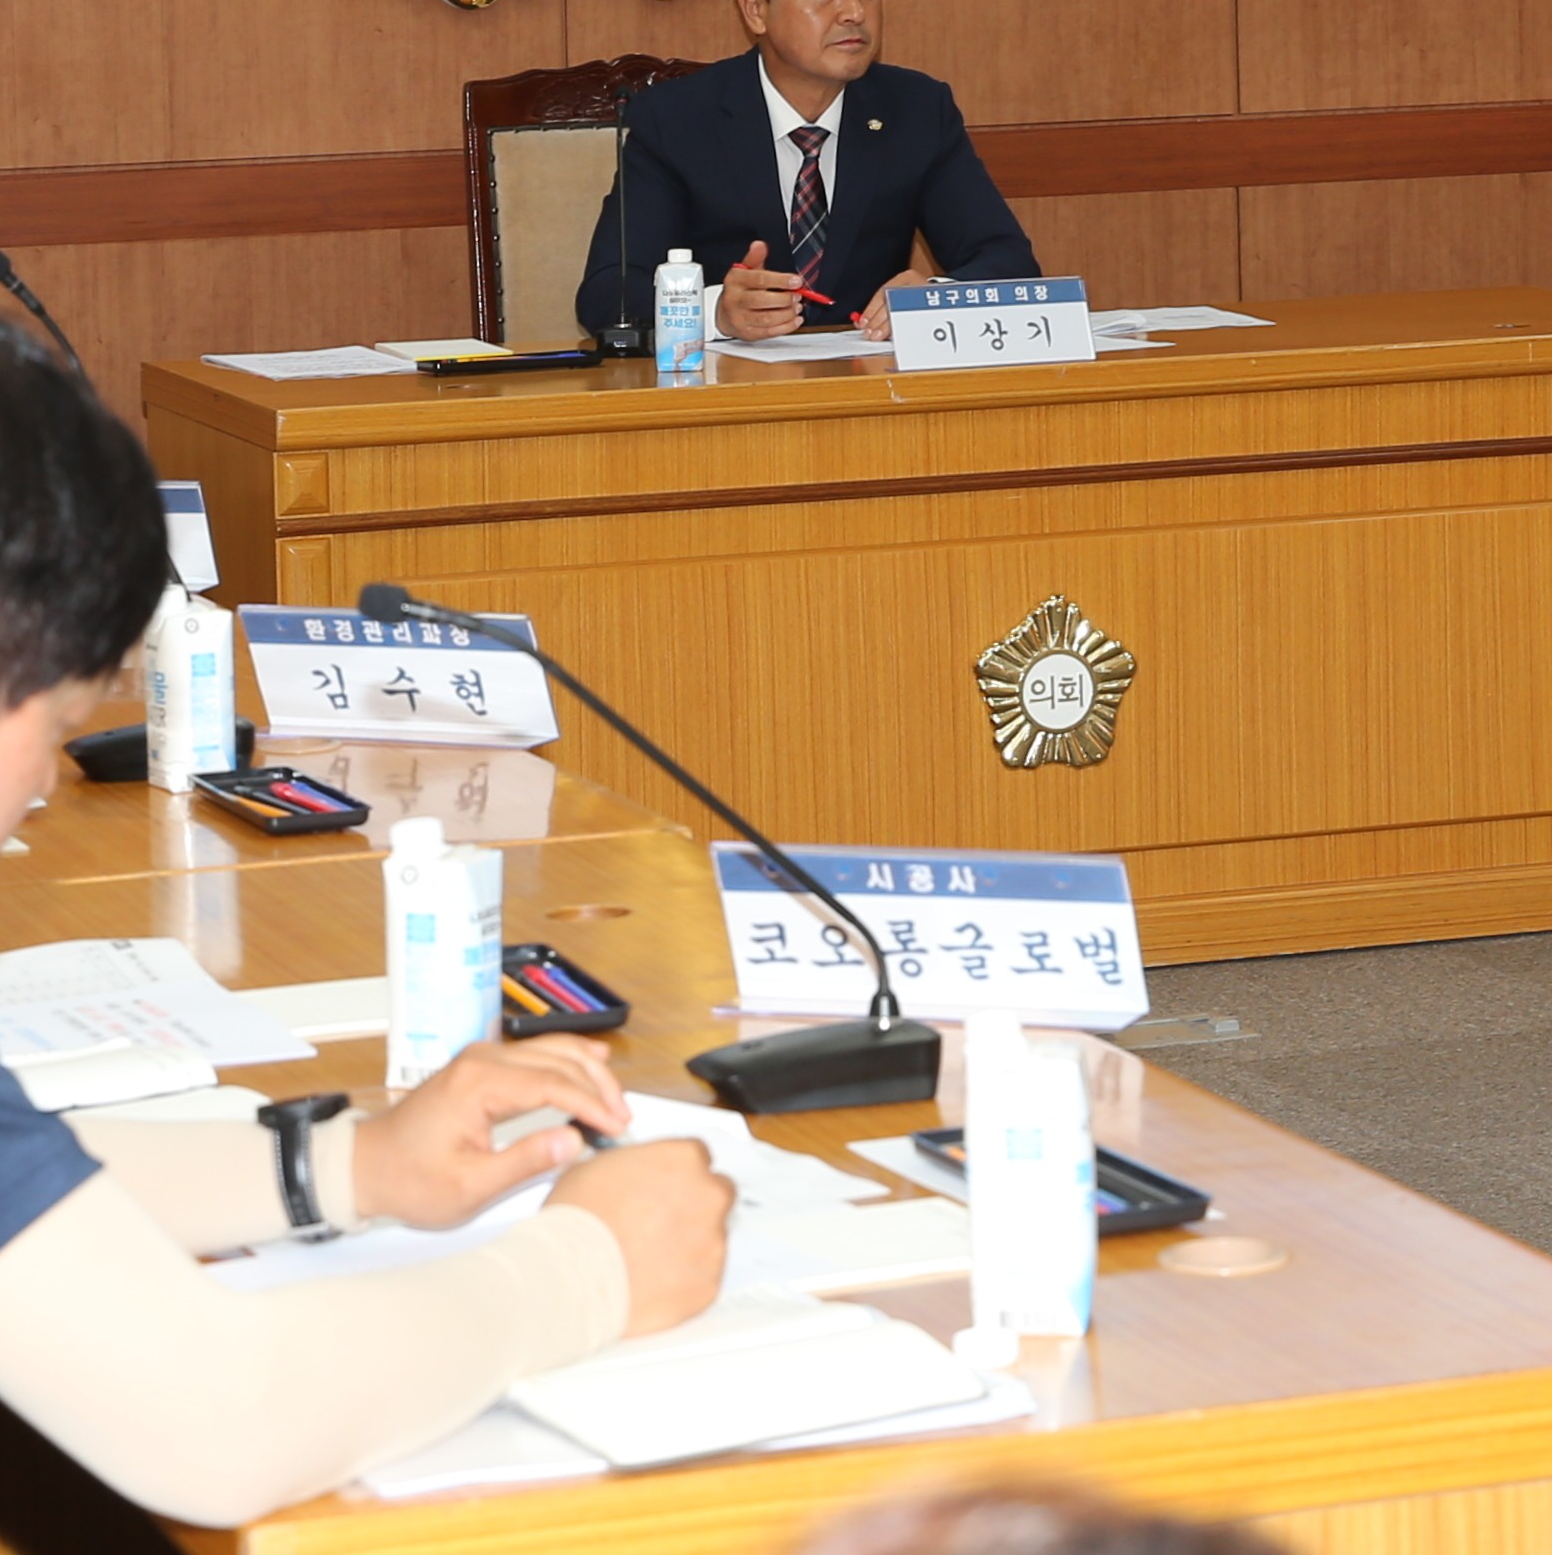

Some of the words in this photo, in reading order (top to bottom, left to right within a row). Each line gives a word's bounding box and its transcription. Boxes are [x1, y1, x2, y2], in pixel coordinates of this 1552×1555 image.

[925, 287, 1000, 307] 남구의회
[1013, 284, 1049, 302] 의장
[932, 315, 1052, 354] 이상기
[310, 663, 489, 717] 김수현
[1027, 672, 1085, 710] 의회
[866, 861, 977, 895] 시공사
[746, 919, 1124, 986] 코오롱글로벌
